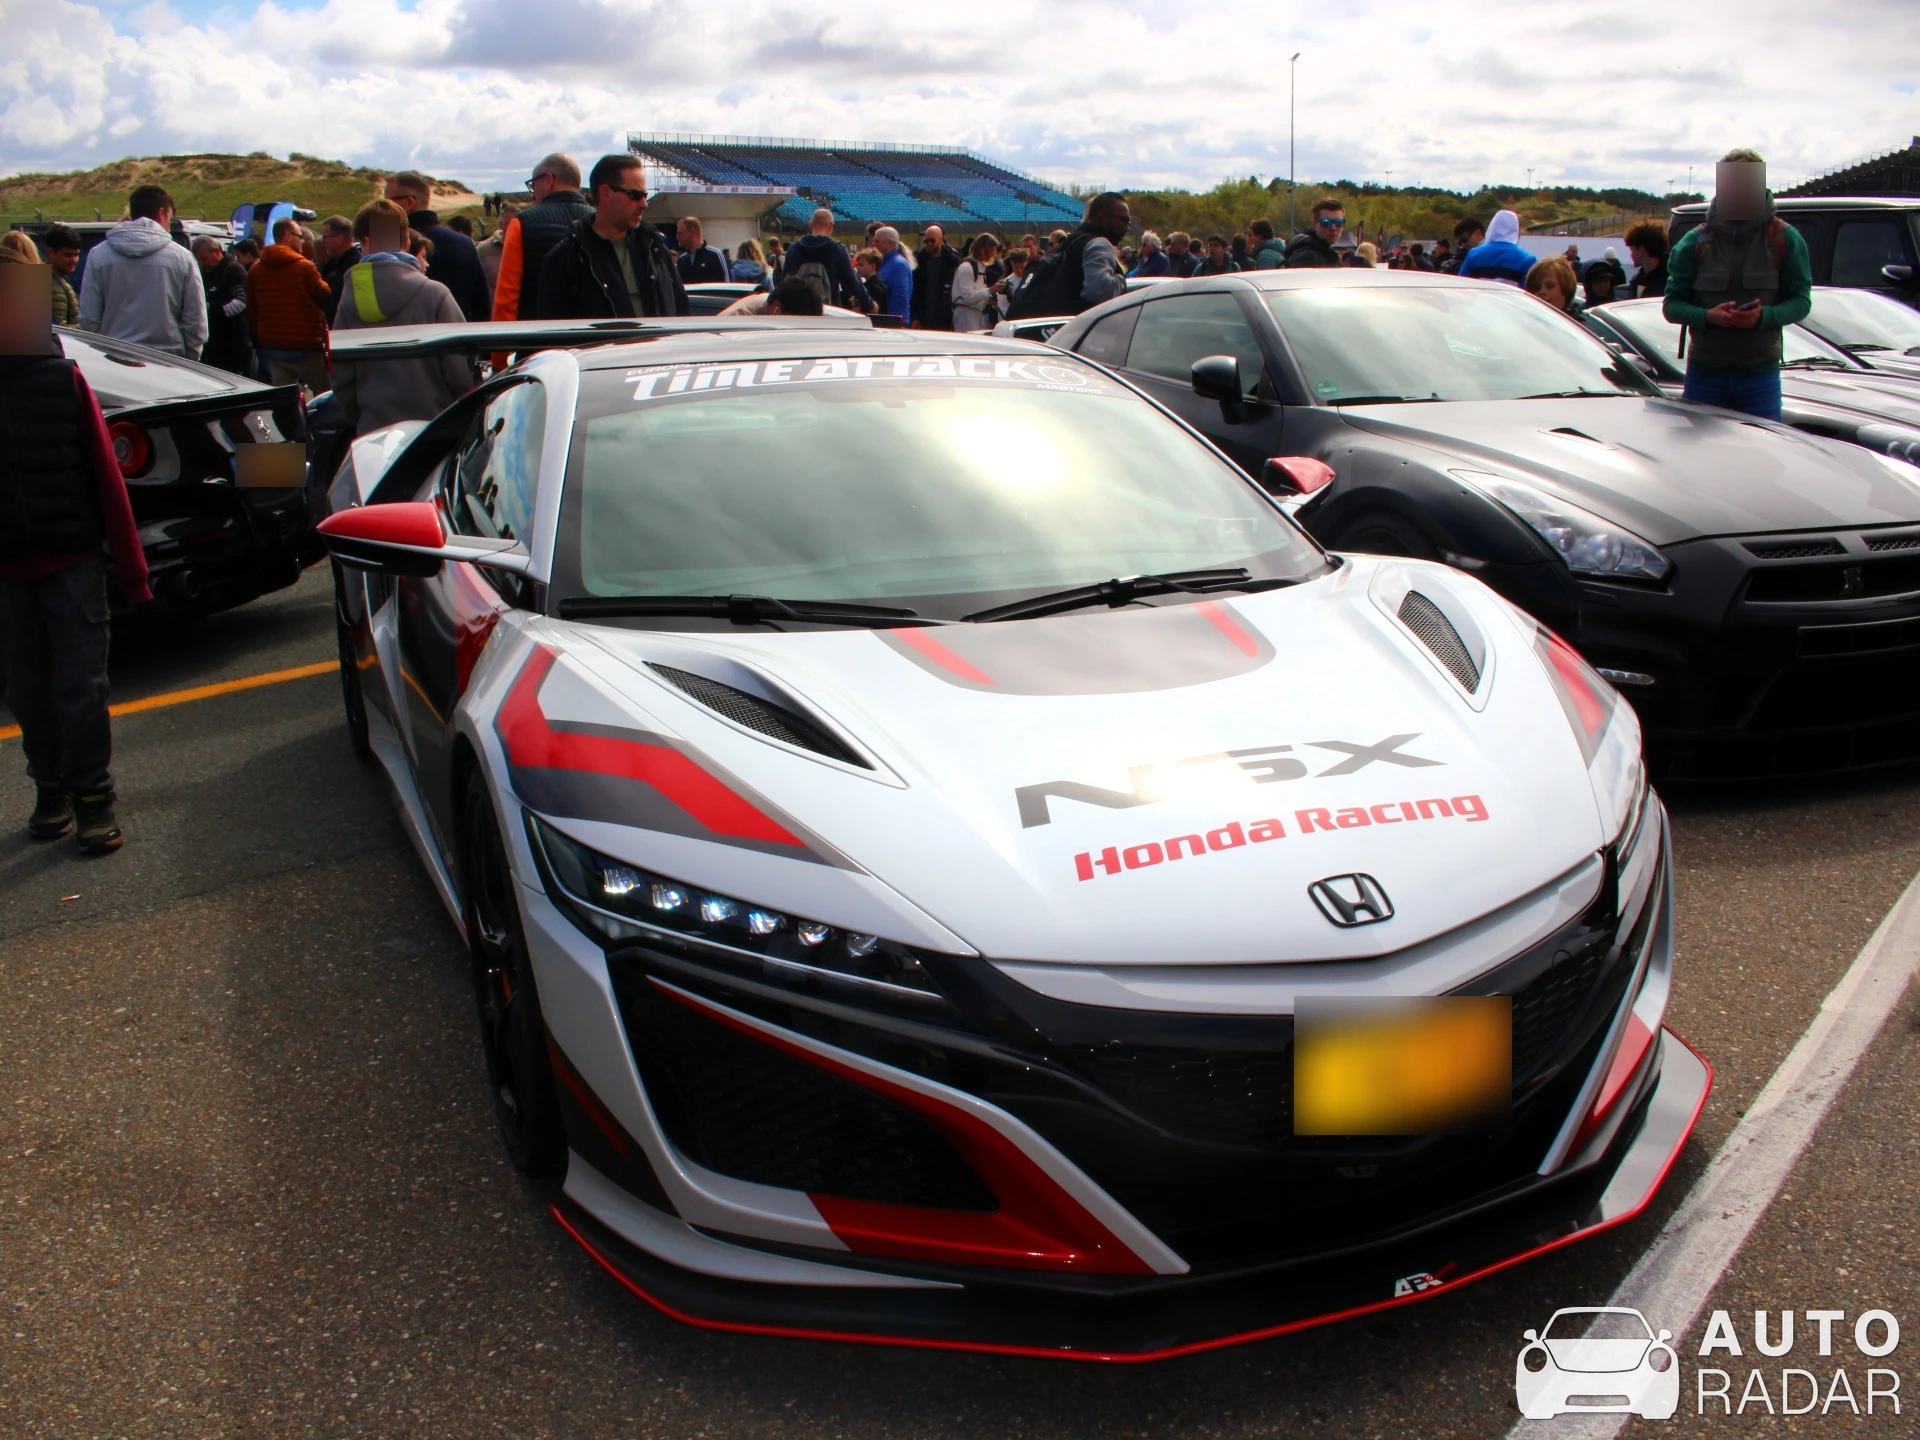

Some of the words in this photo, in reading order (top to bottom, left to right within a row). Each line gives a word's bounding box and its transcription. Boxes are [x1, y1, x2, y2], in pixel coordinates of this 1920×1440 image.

[806, 356, 1040, 381] ATTACK
[1037, 383, 1103, 395] MASTERS
[1074, 820, 1287, 882] Honda
[1294, 794, 1490, 834] Racing
